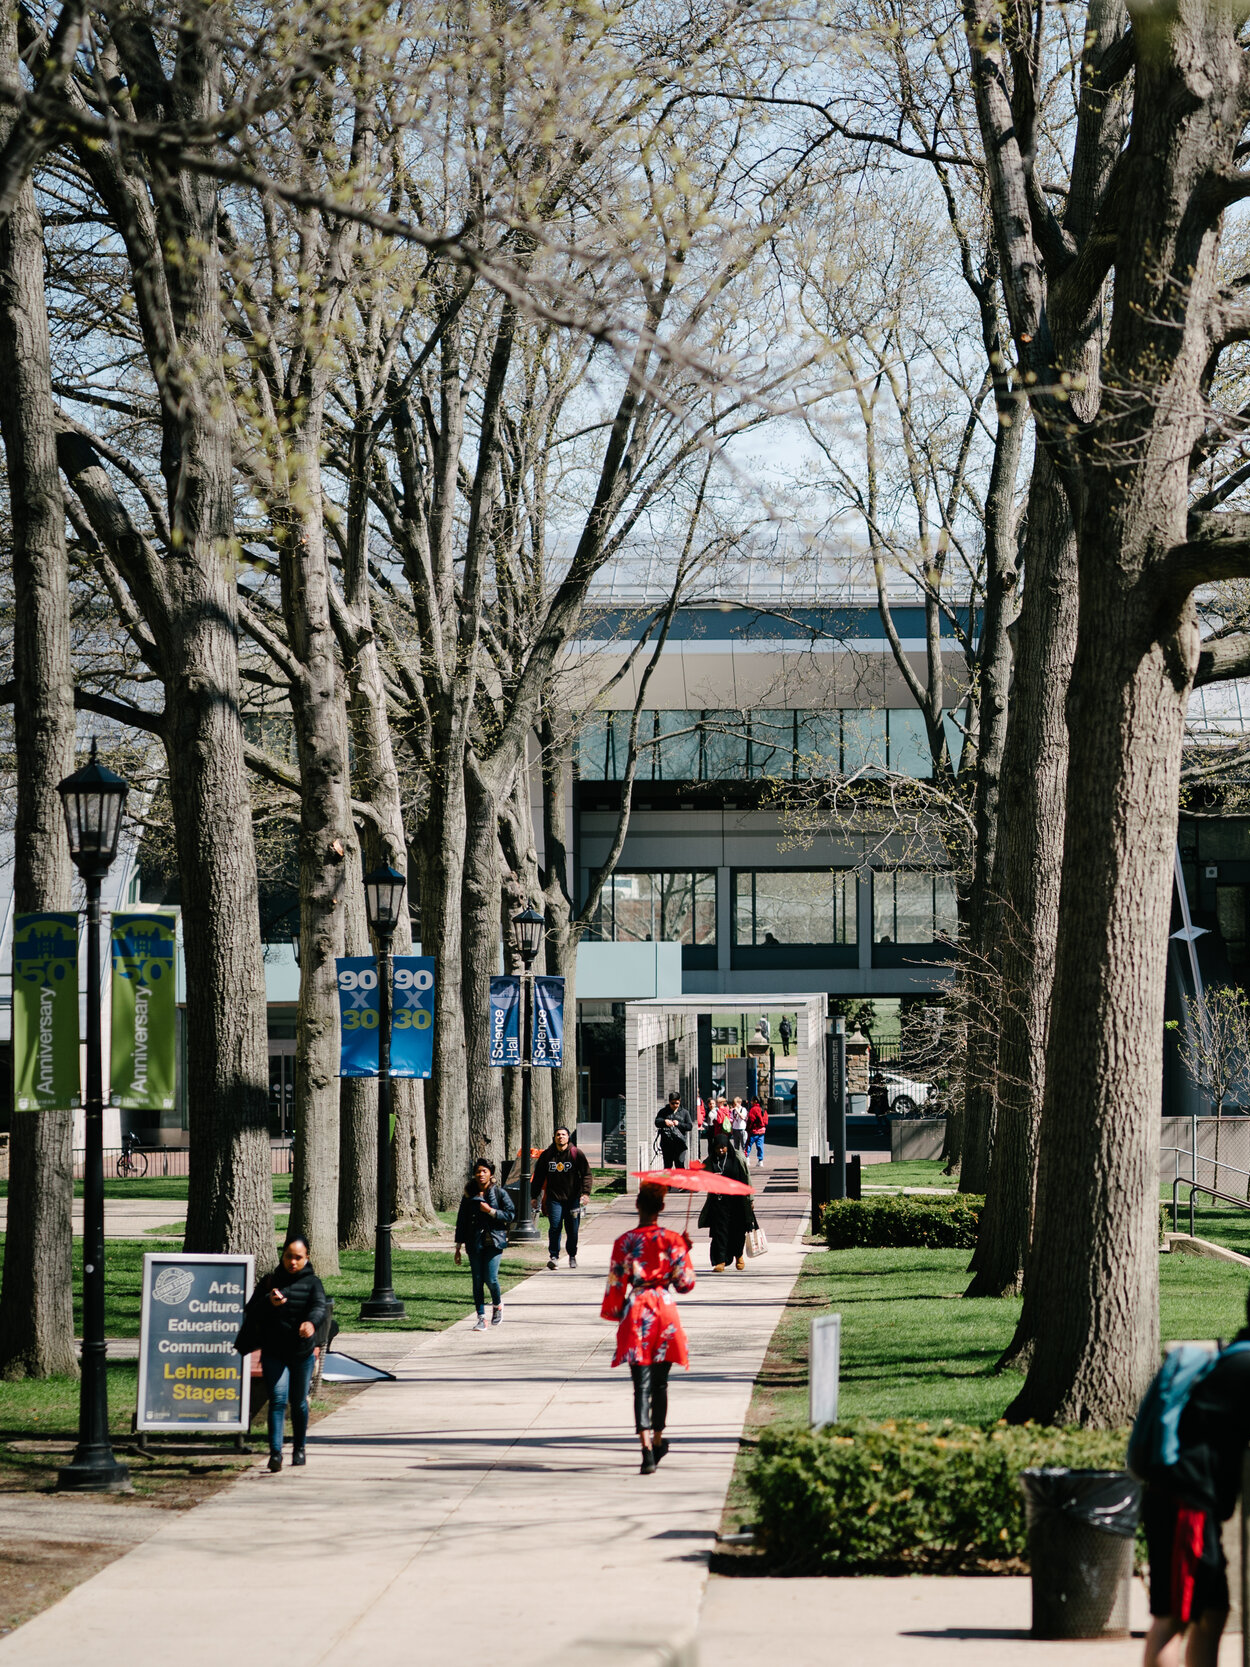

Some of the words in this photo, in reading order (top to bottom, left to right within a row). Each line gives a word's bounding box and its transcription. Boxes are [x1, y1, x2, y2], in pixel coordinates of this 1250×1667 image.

[338, 969, 378, 991] 90
[393, 968, 434, 991] 90
[342, 1008, 380, 1030] 30
[393, 1008, 432, 1030] 30
[36, 986, 57, 1095] Anniversary
[130, 985, 152, 1095] Anniversary
[491, 1009, 505, 1059] Science
[533, 1009, 548, 1059] Science
[505, 1036, 519, 1058] Hall
[548, 1037, 561, 1059] Hall
[208, 1281, 244, 1295] Arts.
[188, 1299, 244, 1314] Culture.
[163, 1362, 241, 1380] Lehman.
[172, 1383, 240, 1404] Stages.
